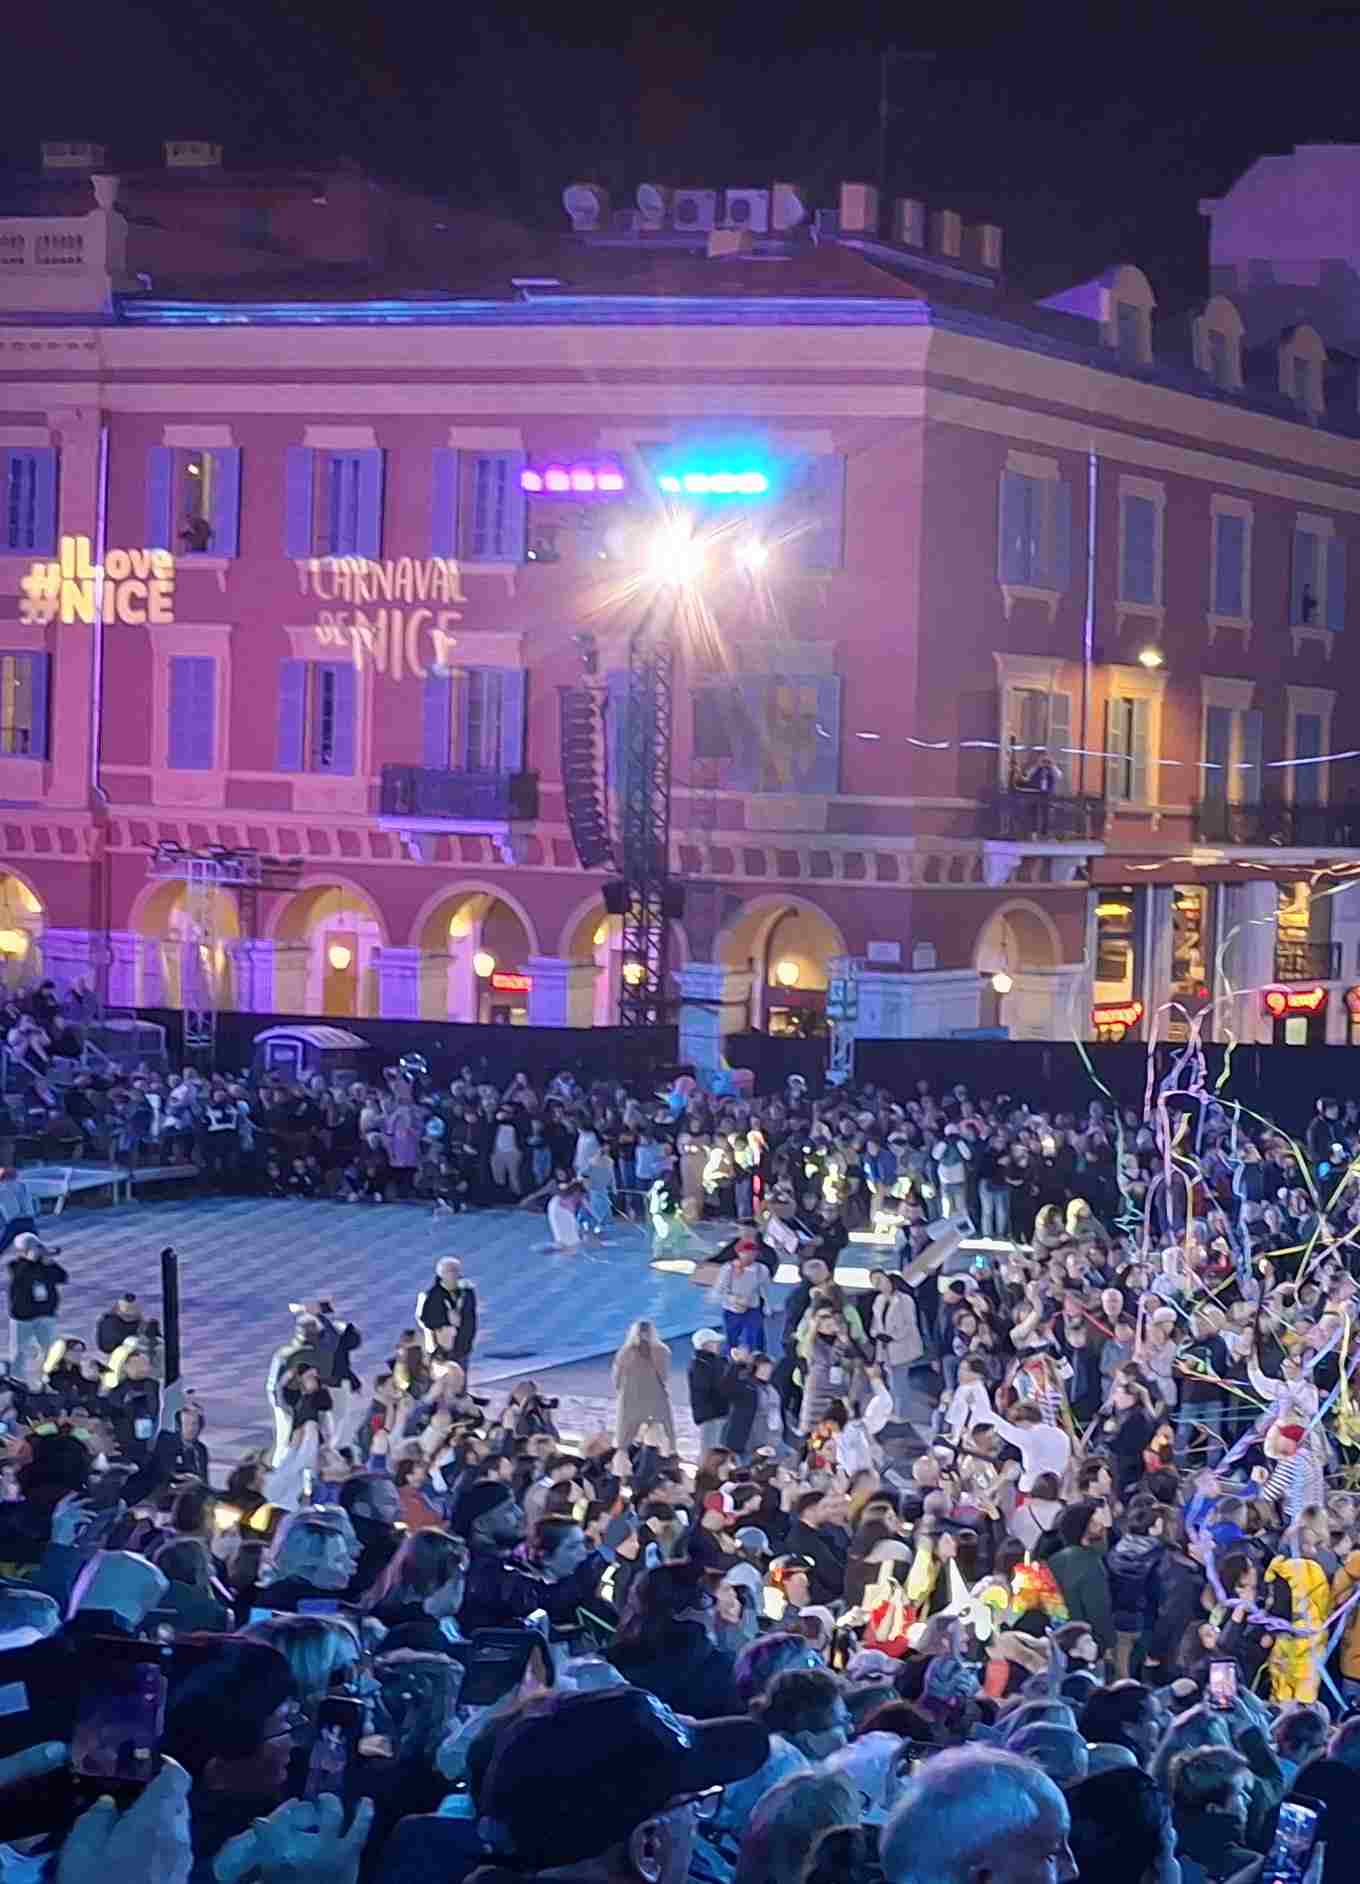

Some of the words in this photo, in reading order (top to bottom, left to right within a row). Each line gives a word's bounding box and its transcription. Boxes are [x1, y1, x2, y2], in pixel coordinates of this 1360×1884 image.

[309, 555, 467, 604] CARNAVAL
[316, 610, 350, 645] DE
[351, 608, 468, 681] NICE
